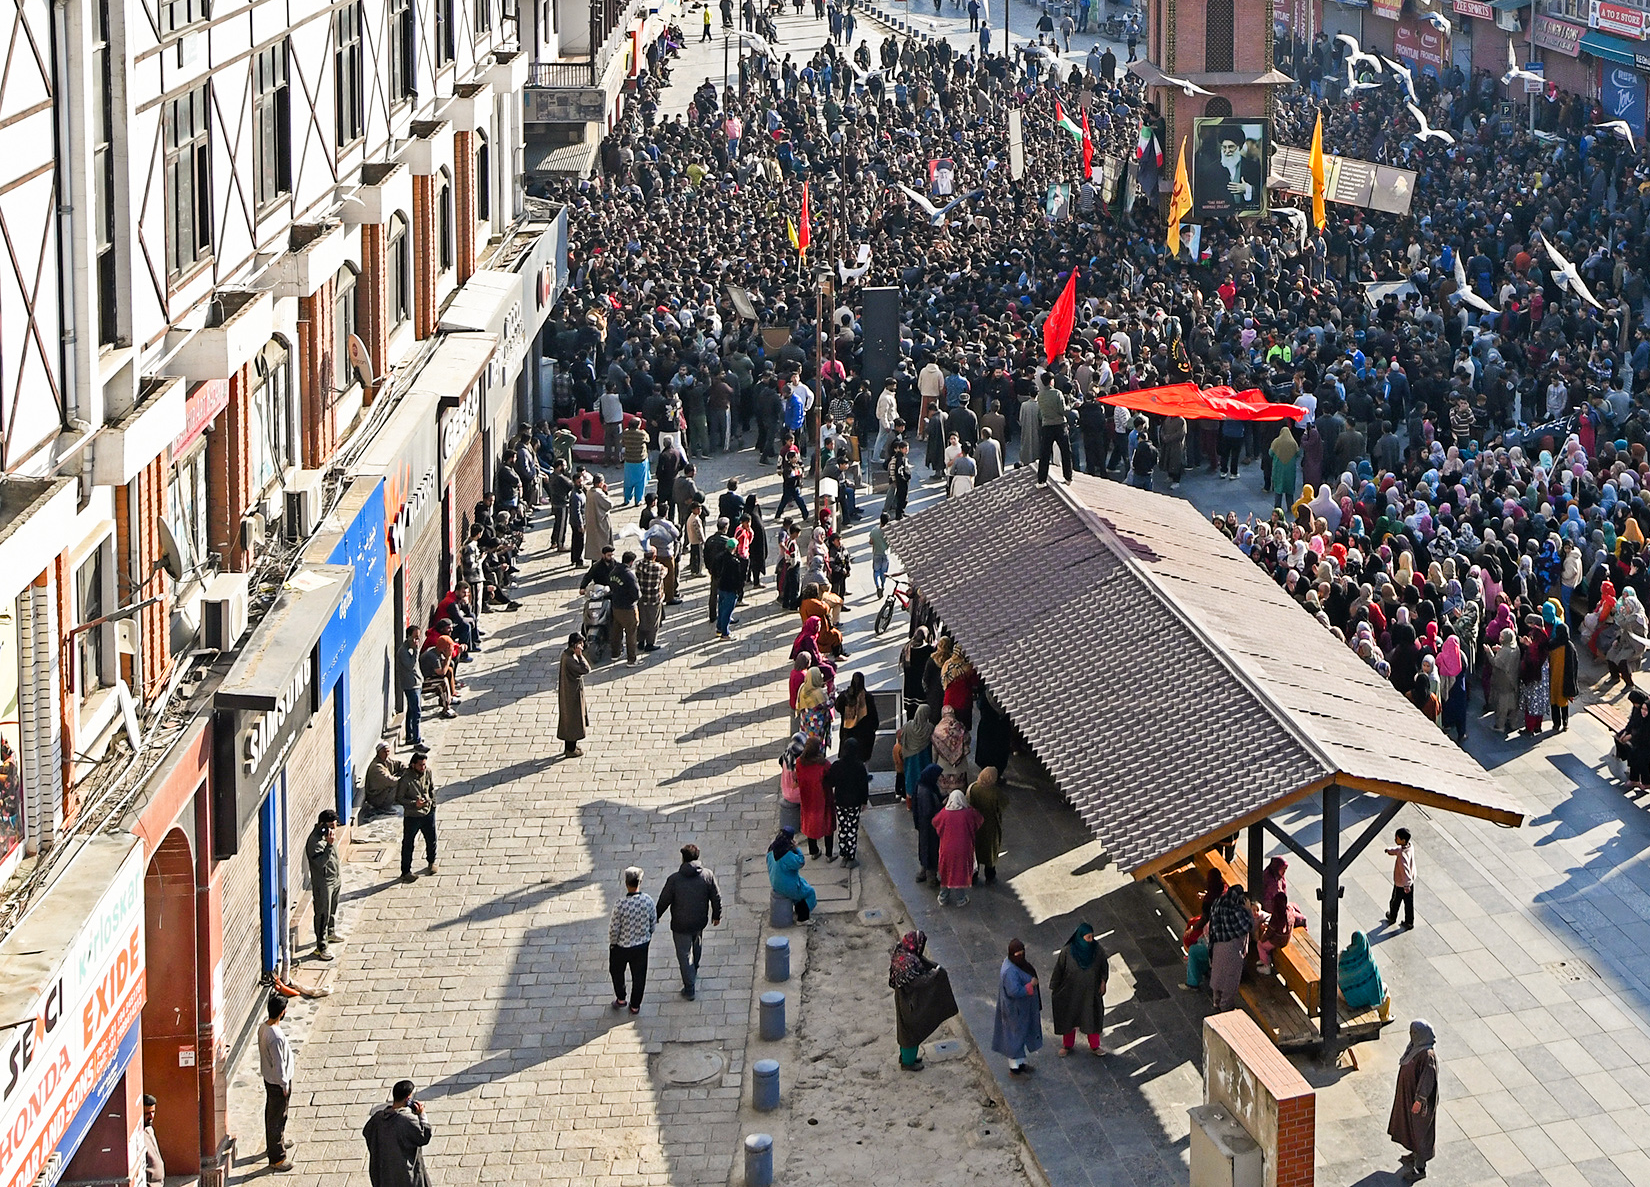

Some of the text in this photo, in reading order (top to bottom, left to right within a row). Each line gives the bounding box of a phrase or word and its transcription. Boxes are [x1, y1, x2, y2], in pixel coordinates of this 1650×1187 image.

[1456, 0, 1489, 16] ZEE SPORTS
[1601, 8, 1606, 17] A
[1606, 9, 1615, 18] TO
[1620, 13, 1641, 25] STORE
[1617, 70, 1638, 85] RUPA
[250, 656, 311, 776] SAMSUNG
[3, 976, 63, 1103] SENCI
[82, 924, 139, 1053] EXIDE
[0, 1044, 71, 1173] HONDA
[40, 1113, 65, 1158] AND
[64, 1066, 96, 1127] SONS
